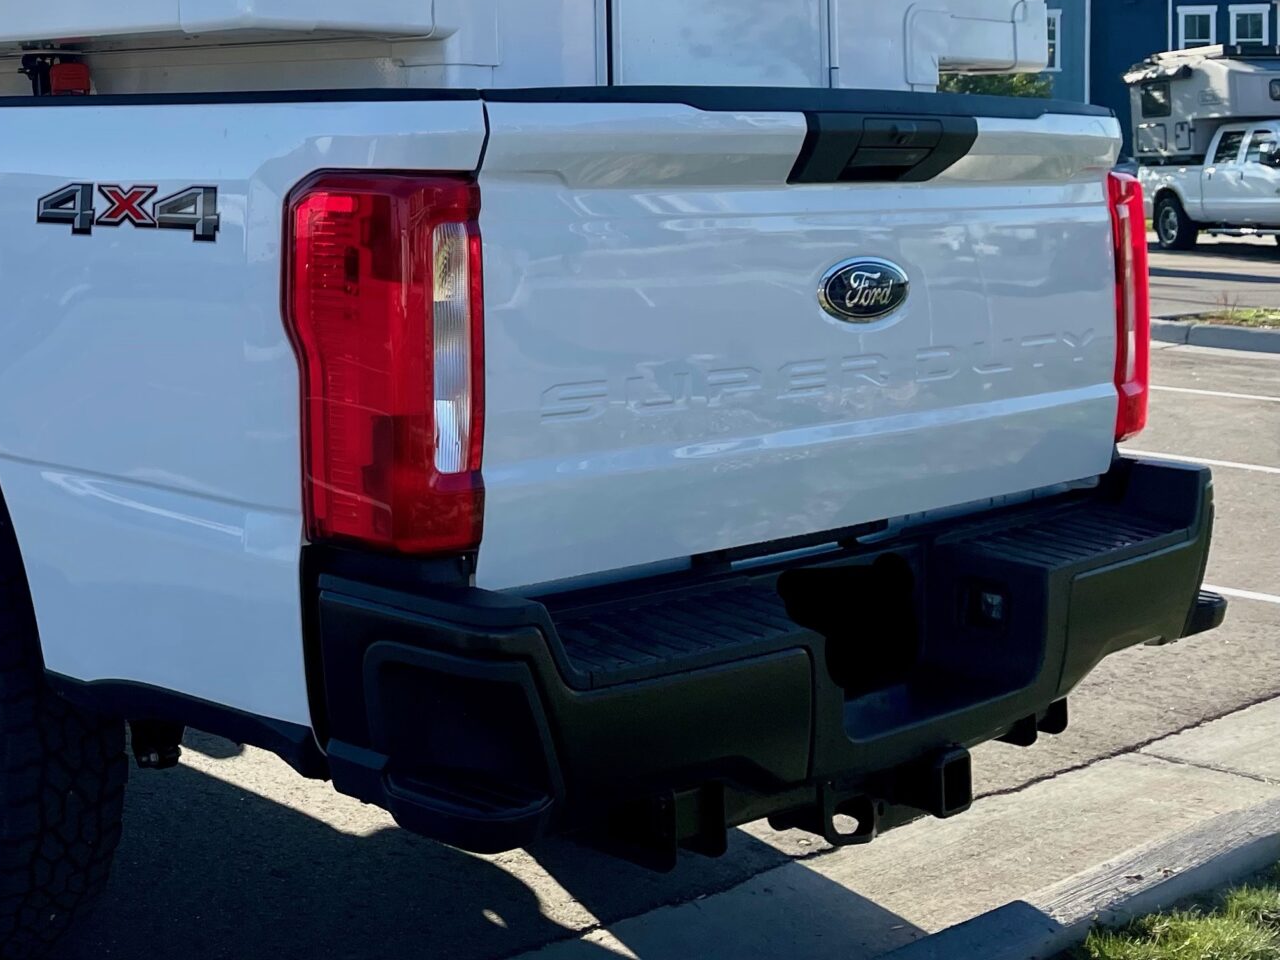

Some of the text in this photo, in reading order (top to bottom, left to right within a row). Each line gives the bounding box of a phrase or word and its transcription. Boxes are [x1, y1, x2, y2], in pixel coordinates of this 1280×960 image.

[845, 271, 893, 308] Ford
[540, 327, 1095, 425] SUPER DUTY
